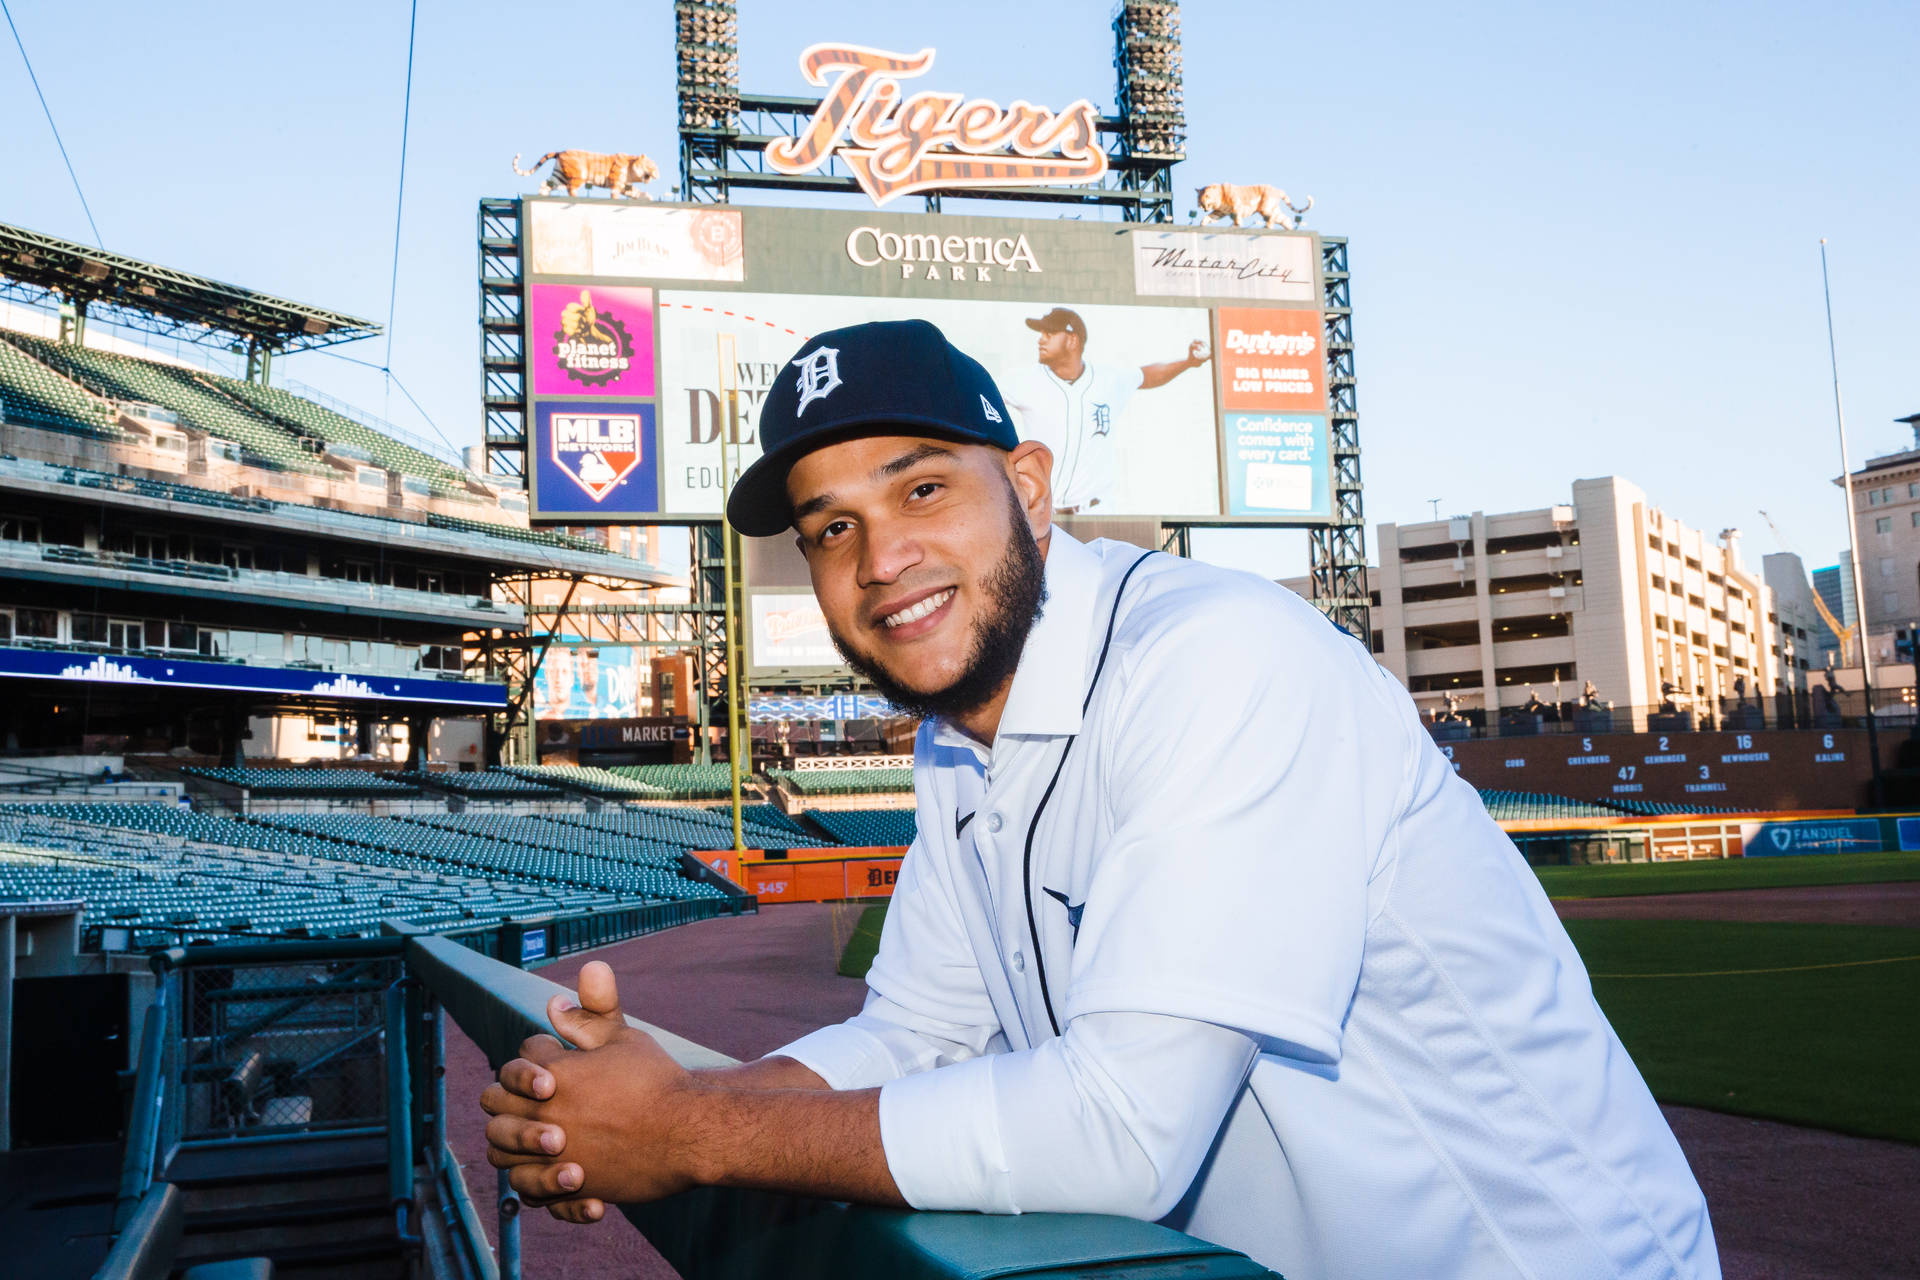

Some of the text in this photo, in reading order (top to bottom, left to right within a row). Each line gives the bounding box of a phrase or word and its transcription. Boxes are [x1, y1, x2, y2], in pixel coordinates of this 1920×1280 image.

[765, 42, 1108, 190] Tigers
[902, 264, 991, 282] PARK
[557, 339, 617, 358] planet
[566, 354, 630, 369] fitness
[1235, 367, 1260, 379] BIG
[792, 346, 844, 418] D
[1233, 380, 1314, 393] LOW PRICES
[1091, 402, 1110, 438] D
[1236, 416, 1313, 433] Confidence
[557, 418, 635, 443] MLB
[1237, 432, 1315, 447] comes with
[558, 443, 635, 453] NETWORK
[1238, 449, 1277, 464] every
[622, 726, 676, 742] MARKET
[1823, 734, 1834, 749] 6
[1582, 738, 1592, 752] 5
[1659, 737, 1669, 750] 2
[1736, 735, 1752, 749] 16
[1617, 766, 1636, 780] 47
[1699, 766, 1710, 780] 3
[1794, 827, 1854, 840] FANDUEL
